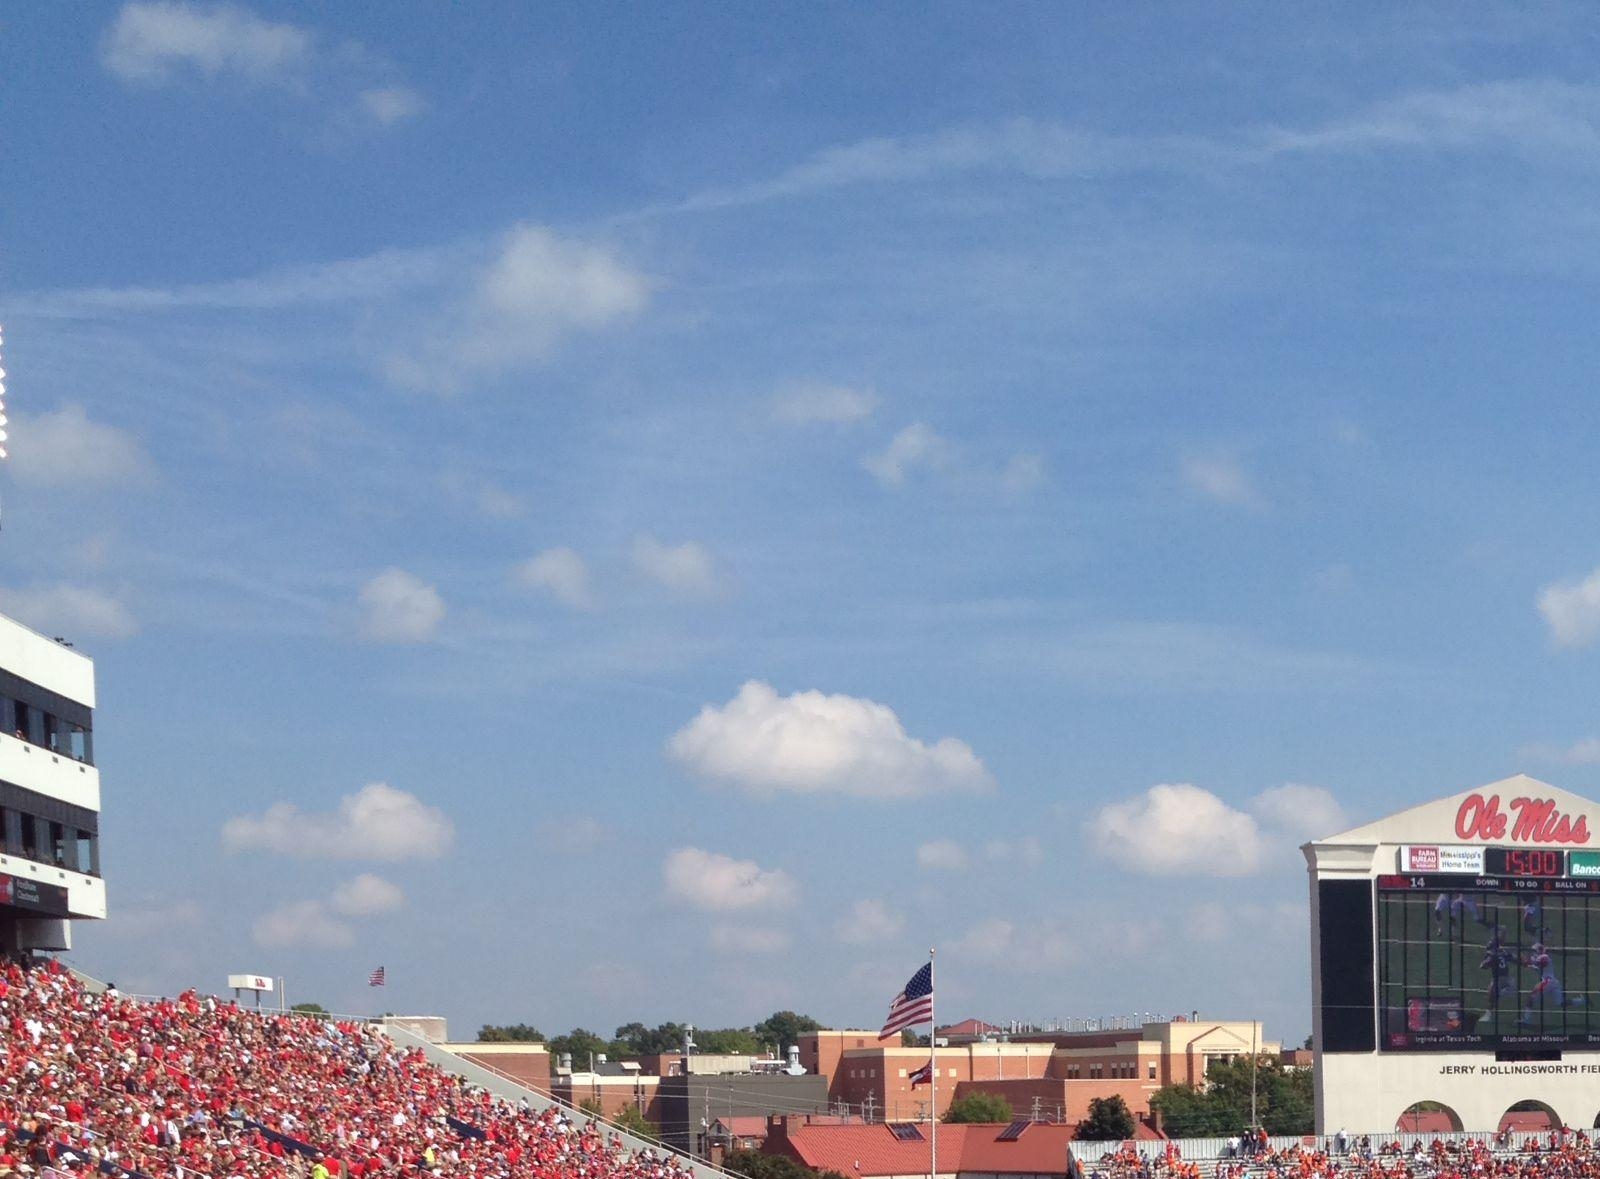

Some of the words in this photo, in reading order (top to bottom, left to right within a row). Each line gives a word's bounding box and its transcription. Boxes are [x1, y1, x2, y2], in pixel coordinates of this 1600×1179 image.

[1455, 794, 1507, 840] Ole
[1510, 797, 1591, 843] Miss
[1506, 851, 1556, 874] 15:00
[1410, 878, 1425, 888] 14
[1440, 1066, 1475, 1075] JERRY
[1481, 1065, 1578, 1075] HOLLINGSWORTH
